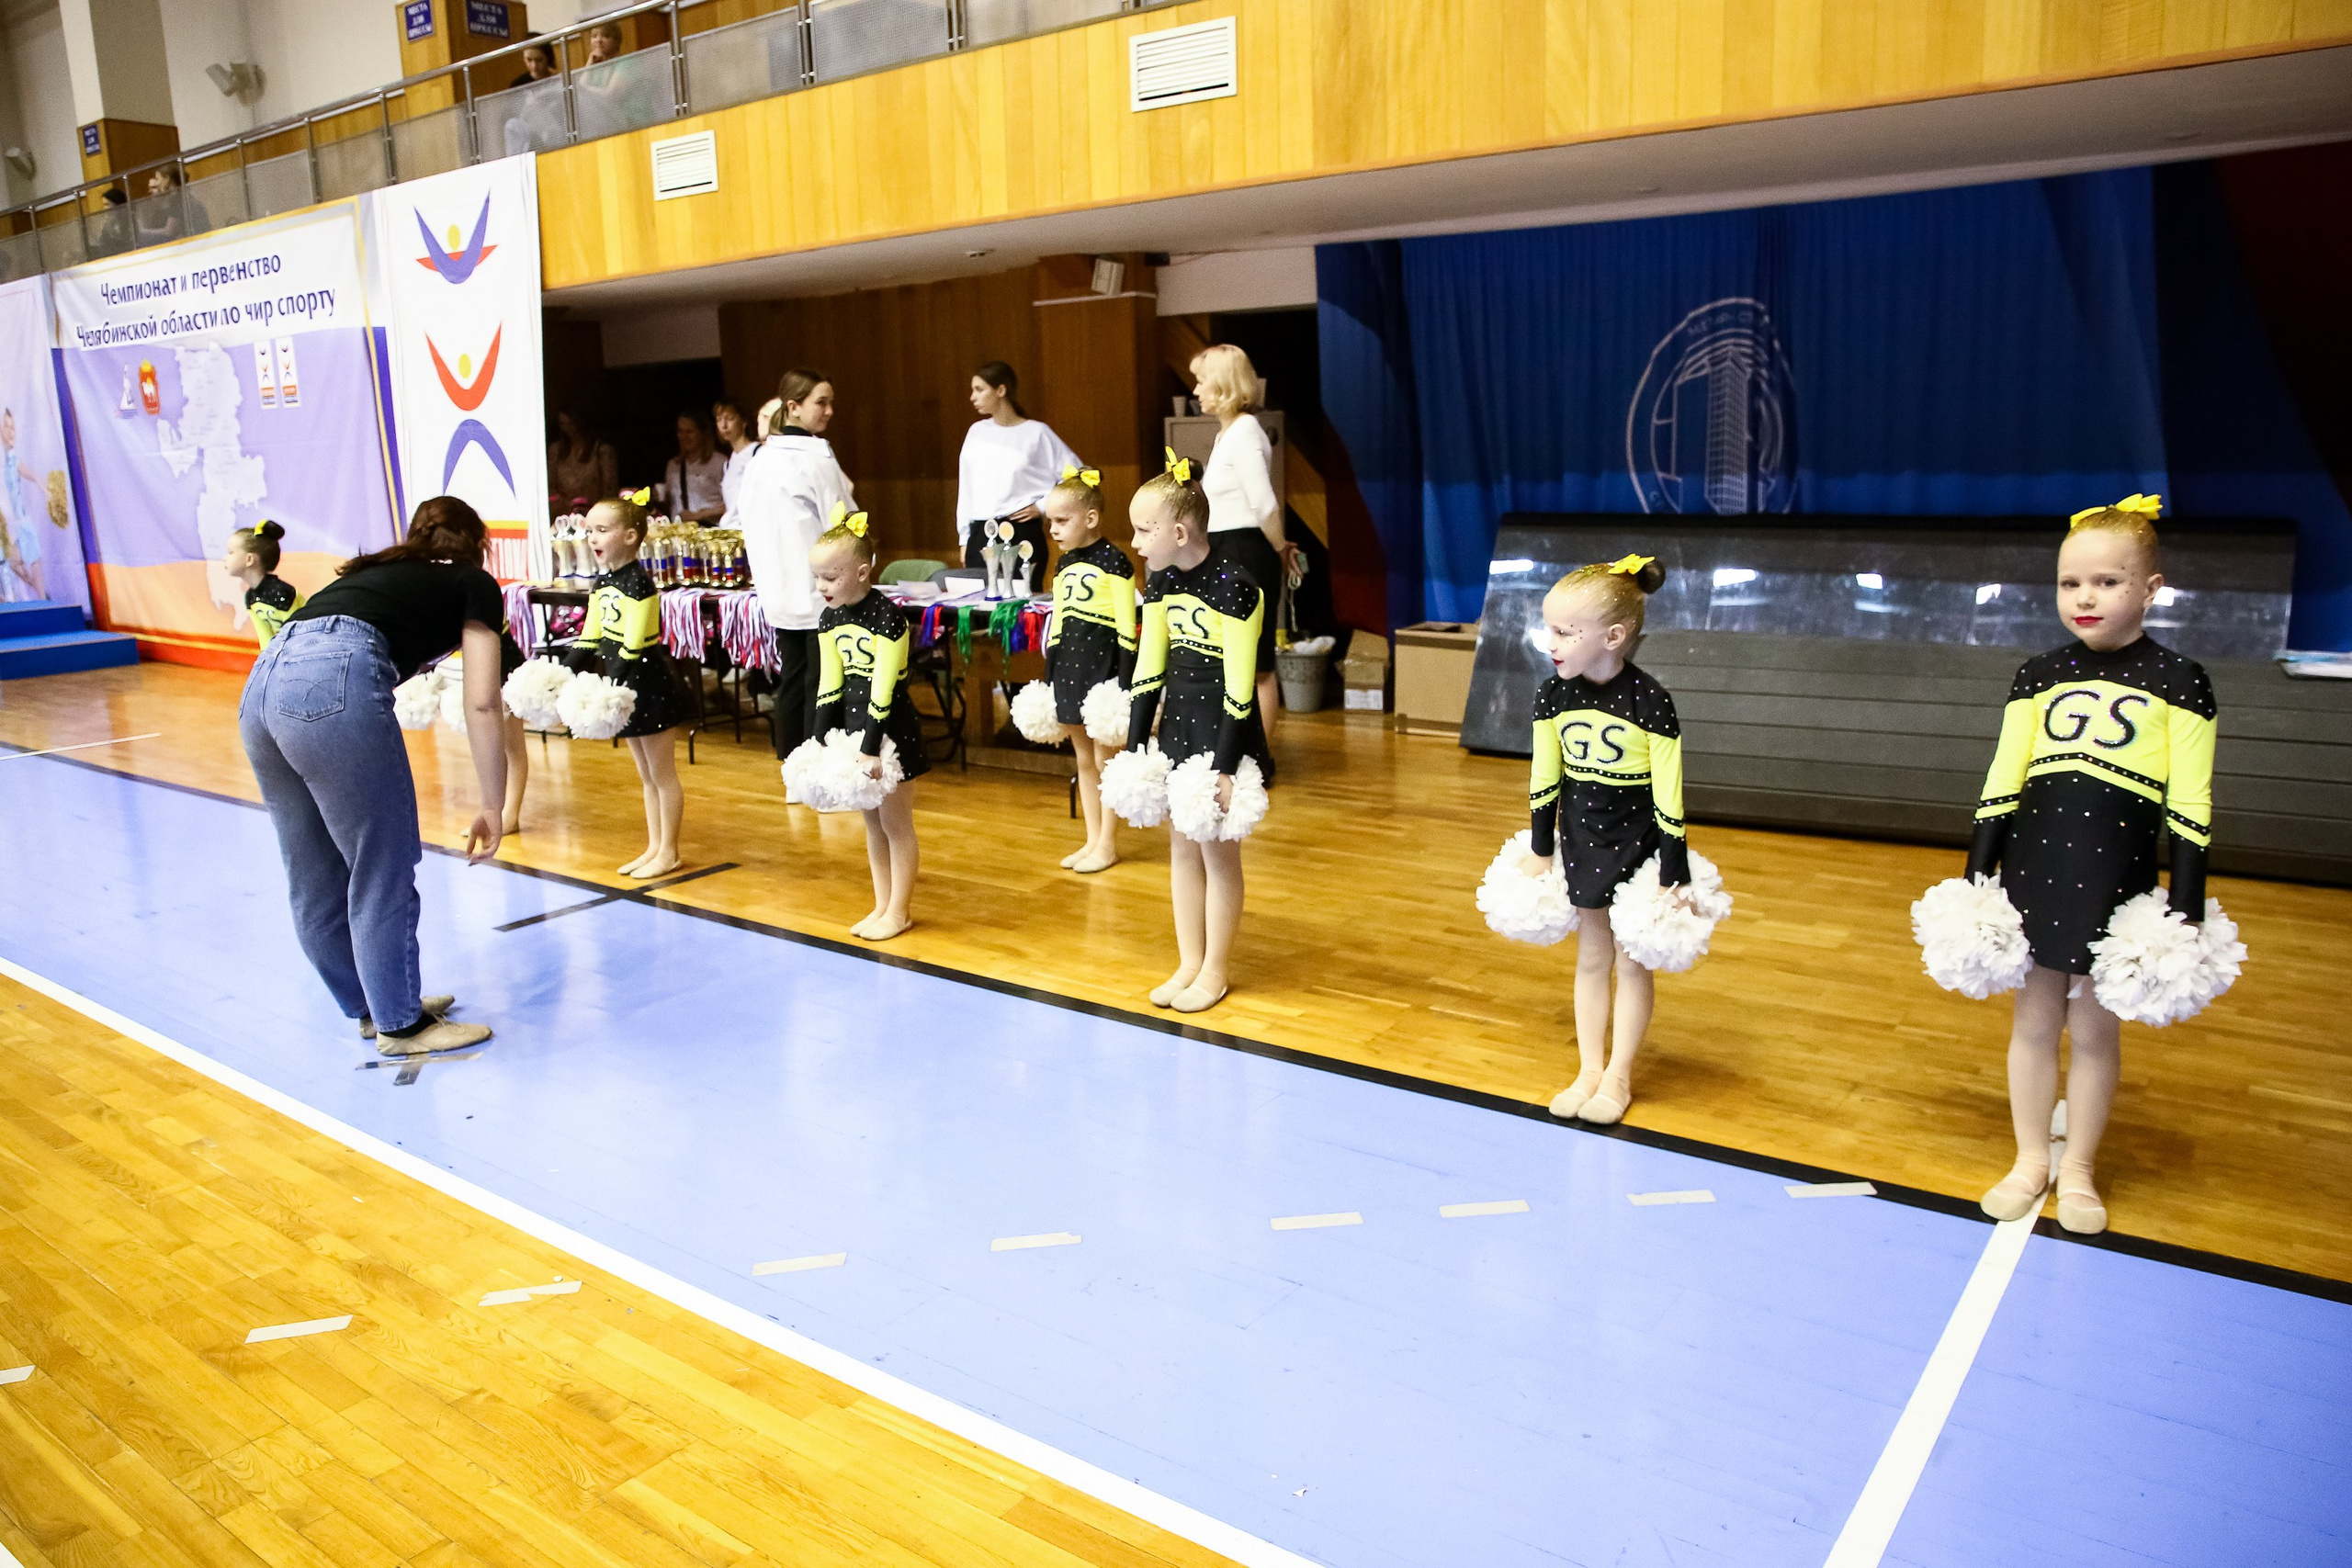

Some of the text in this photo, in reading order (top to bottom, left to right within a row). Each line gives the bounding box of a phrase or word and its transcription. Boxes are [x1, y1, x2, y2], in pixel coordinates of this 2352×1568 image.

[100, 254, 281, 305] Чемпионат и первенство
[76, 288, 335, 347] Челябинской области по чир спорту
[1060, 572, 1097, 602] GS
[834, 634, 875, 665] GS
[1560, 720, 1626, 765] GS
[2043, 688, 2150, 750] GS
